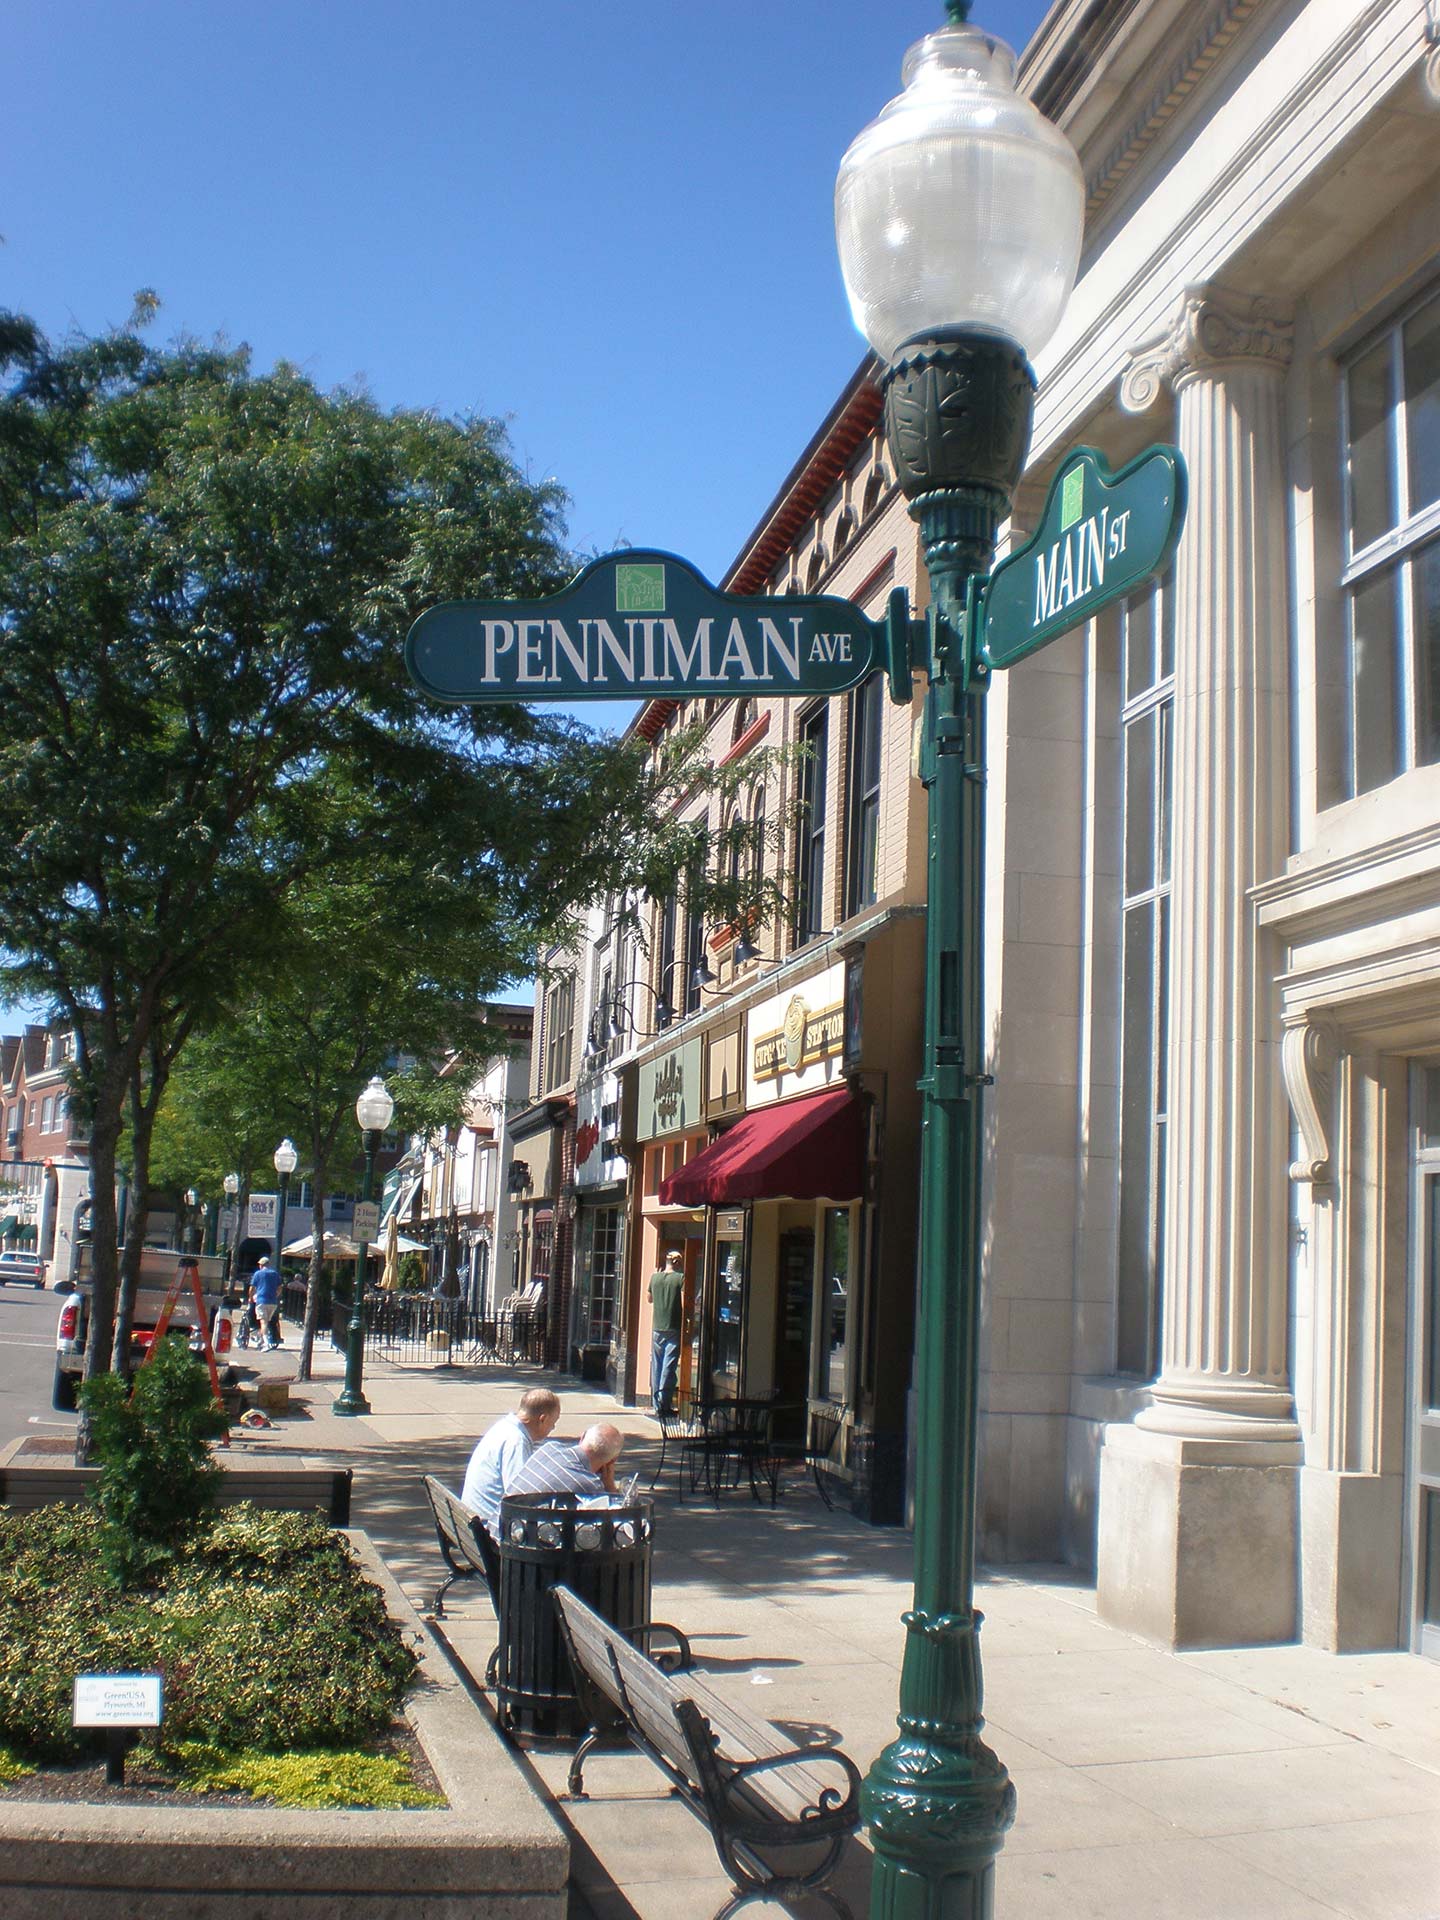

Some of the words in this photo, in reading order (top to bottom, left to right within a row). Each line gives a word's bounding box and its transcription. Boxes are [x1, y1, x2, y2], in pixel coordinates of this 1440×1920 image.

[1033, 506, 1109, 627] MAIN
[1110, 510, 1130, 560] ST
[480, 617, 803, 682] PENNIMAN
[807, 632, 853, 663] AVE
[755, 1037, 787, 1068] CUPCKE
[806, 1011, 844, 1049] STATION
